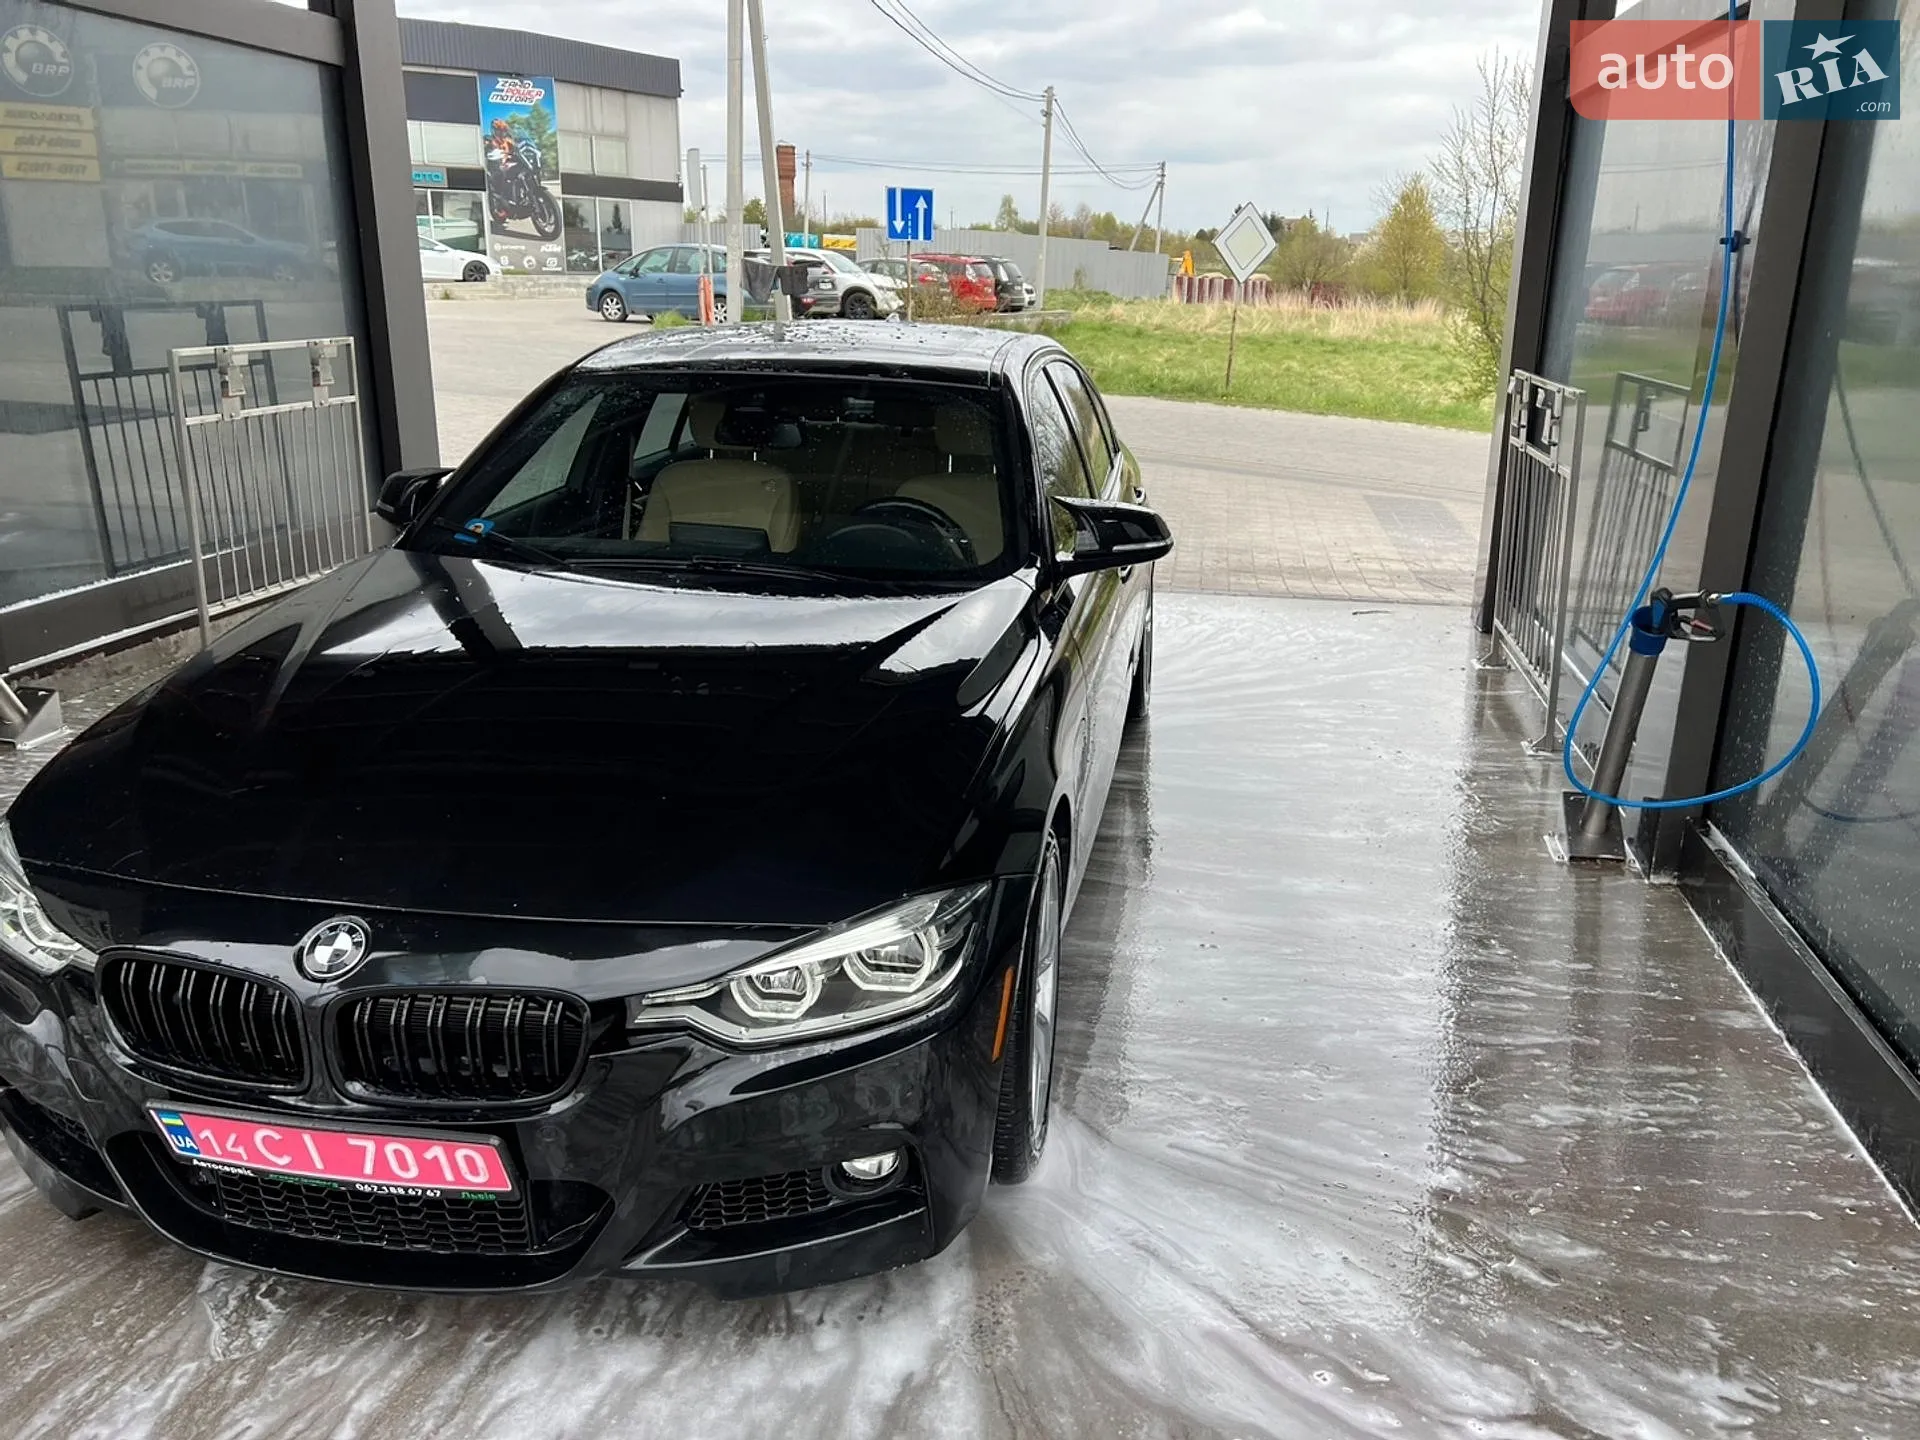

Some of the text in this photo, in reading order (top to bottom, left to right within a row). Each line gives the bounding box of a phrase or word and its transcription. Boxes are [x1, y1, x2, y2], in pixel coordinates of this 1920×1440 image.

[32, 62, 70, 77] BRP
[161, 76, 196, 89] BRP
[491, 94, 534, 103] MOTORS
[171, 1134, 199, 1150] UA
[347, 1137, 488, 1183] 7010
